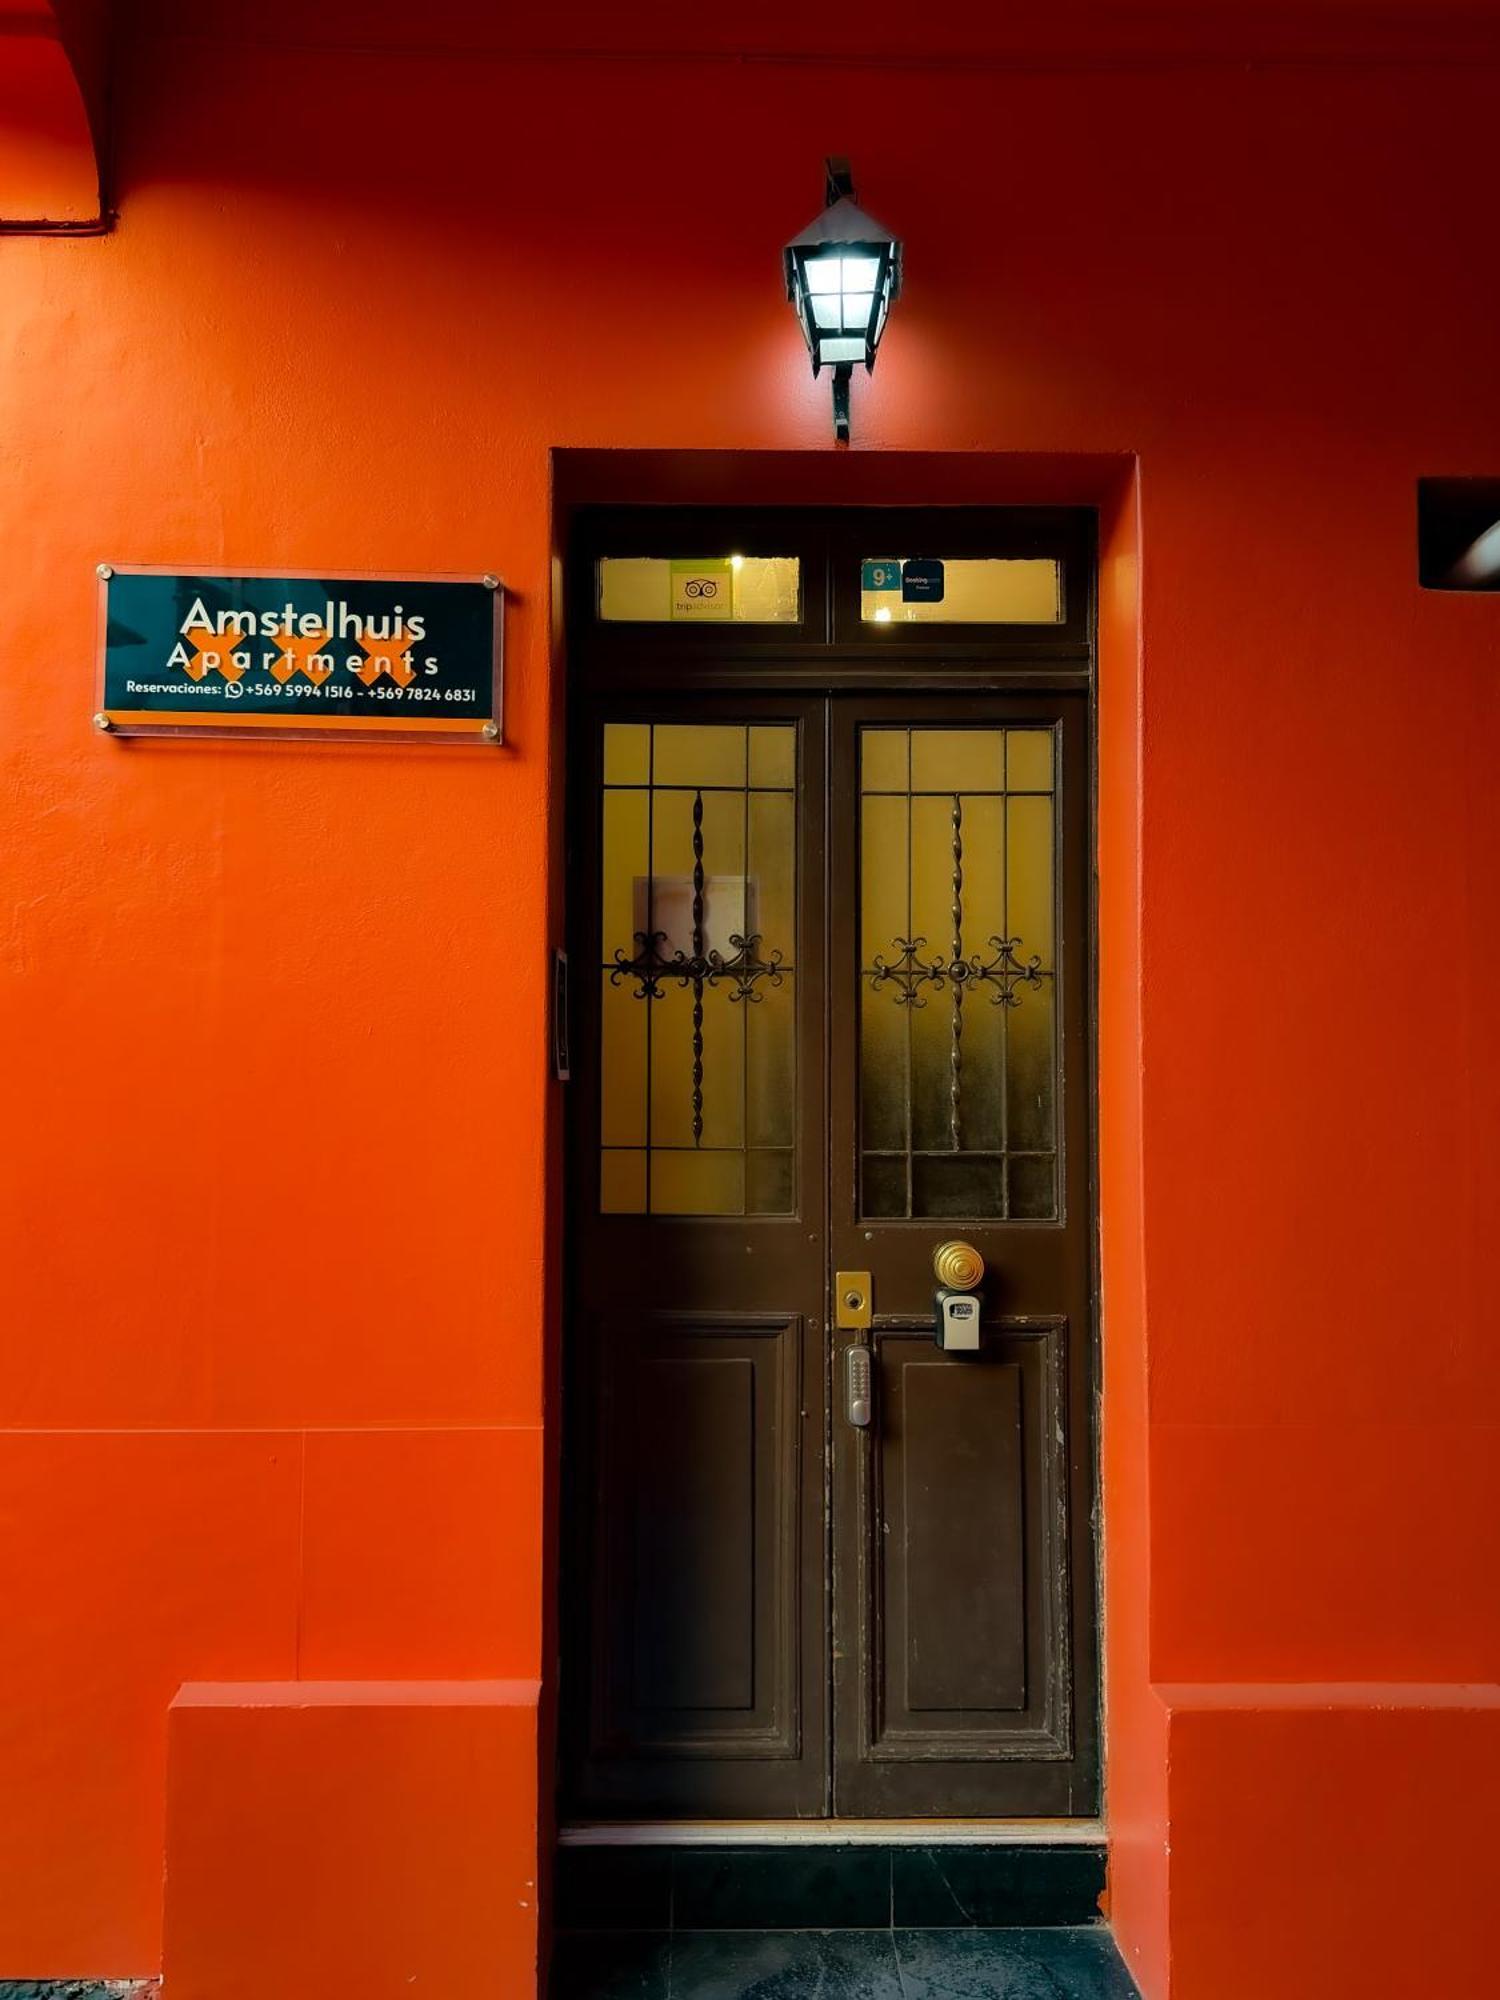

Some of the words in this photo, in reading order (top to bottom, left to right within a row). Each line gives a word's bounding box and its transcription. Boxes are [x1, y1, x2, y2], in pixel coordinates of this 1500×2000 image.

[180, 597, 426, 641] Amstelhuis
[166, 642, 439, 675] Apartments
[126, 680, 222, 695] Reservaciones:
[246, 683, 281, 697] +569
[285, 684, 322, 698] 5994
[325, 685, 354, 699] 1516
[368, 687, 404, 700] +569
[407, 688, 441, 701] 7824
[444, 689, 476, 702] 6831
